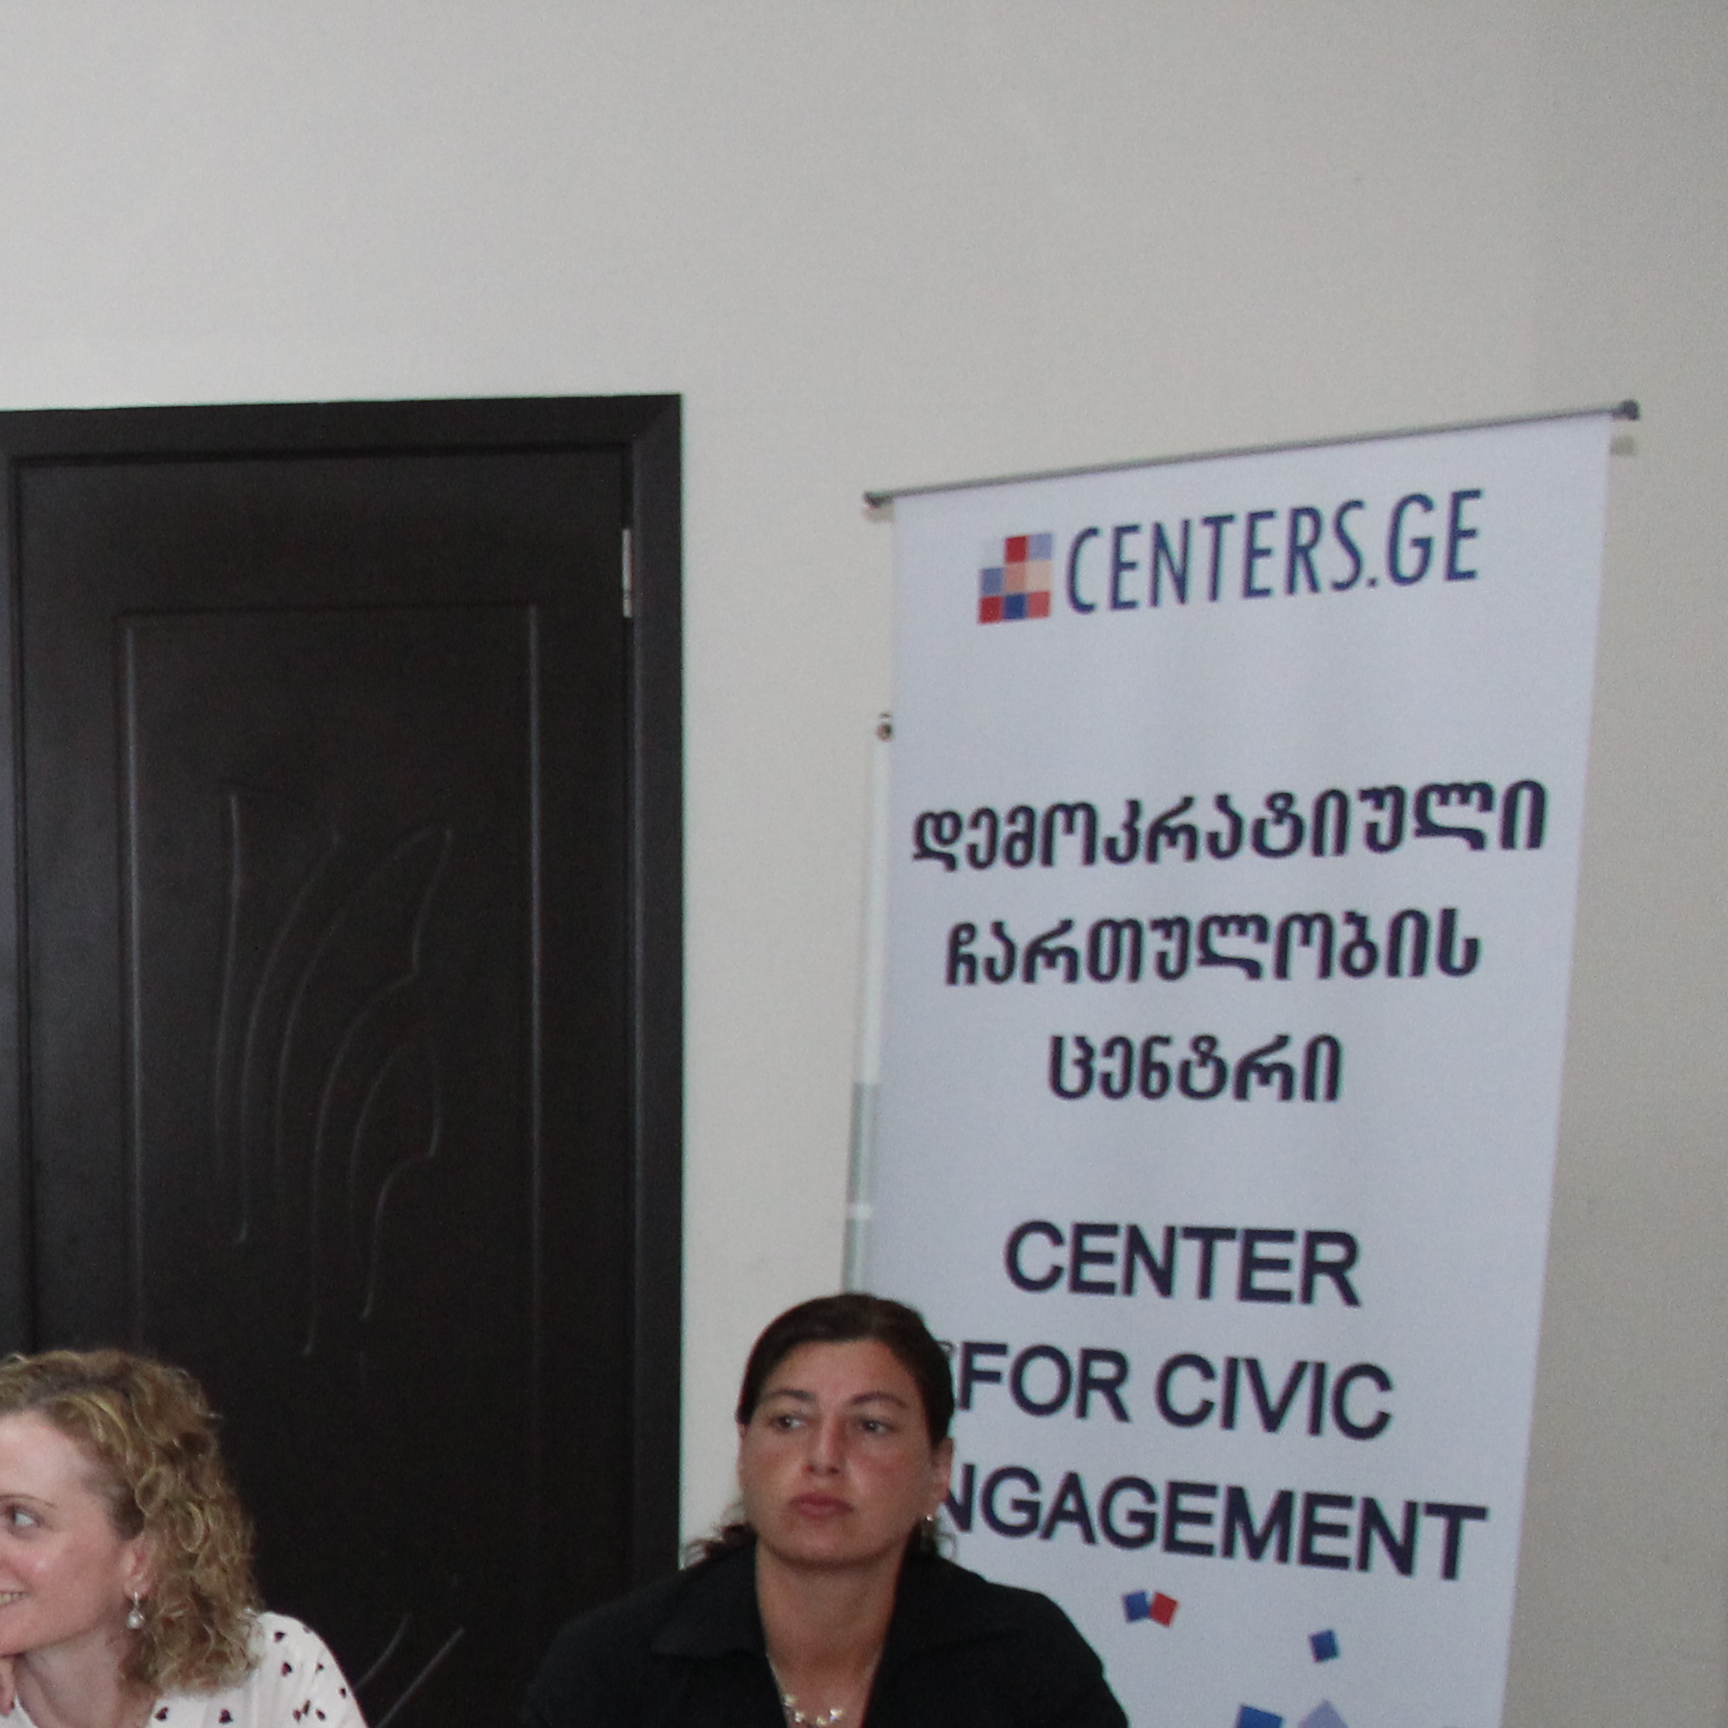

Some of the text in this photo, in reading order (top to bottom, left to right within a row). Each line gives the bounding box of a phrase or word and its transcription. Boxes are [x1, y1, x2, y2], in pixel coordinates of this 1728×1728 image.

[1066, 488, 1483, 615] CENTERS.GE
[912, 778, 1547, 873] დემოკრატიული
[945, 907, 1481, 986] ჩართულობის
[1048, 1033, 1343, 1103] ცენტრი
[1004, 1219, 1361, 1308] CENTER
[956, 1341, 1393, 1442] FOR CIVIC
[944, 1464, 1488, 1581] NGAGEMENT
